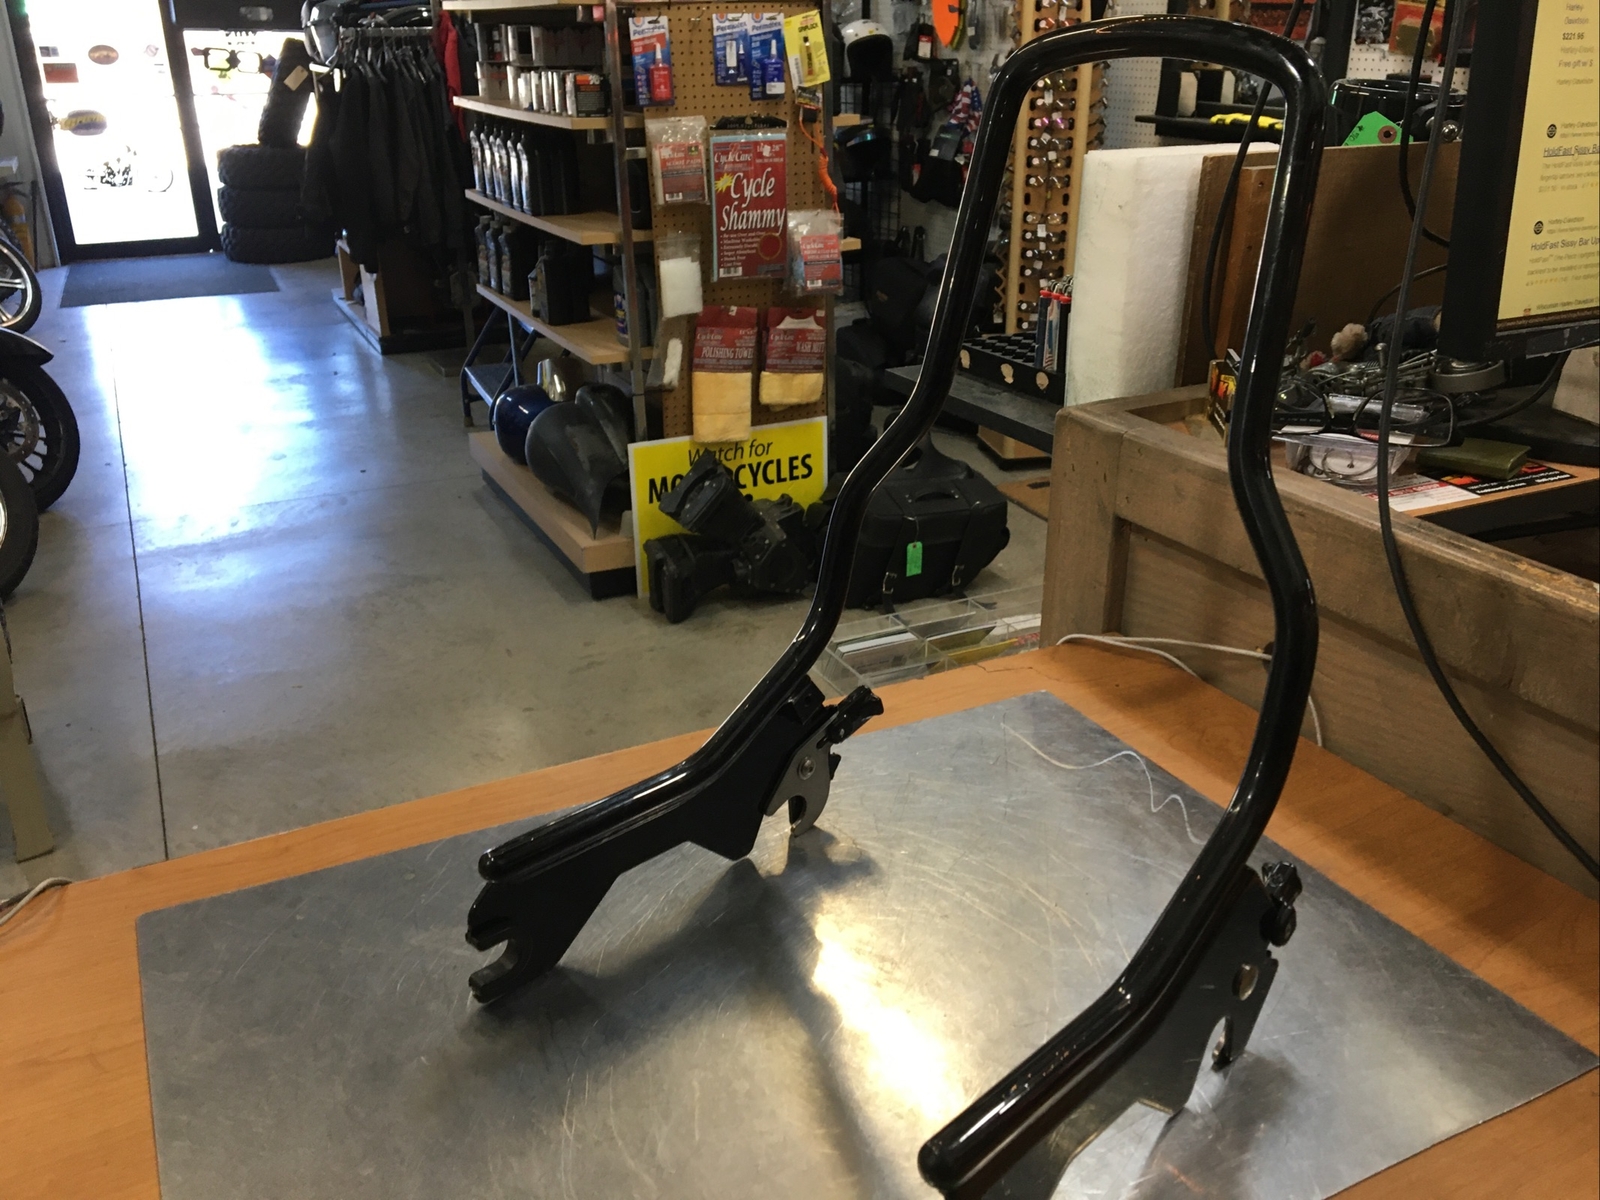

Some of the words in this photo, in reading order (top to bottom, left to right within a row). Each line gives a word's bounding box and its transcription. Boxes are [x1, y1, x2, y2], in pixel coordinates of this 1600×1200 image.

[752, 22, 781, 31] Permatex
[1543, 146, 1573, 156] HoldFast
[730, 167, 775, 208] Cycle
[720, 201, 786, 236] Shammy
[1530, 241, 1560, 251] HoldFast
[1560, 239, 1577, 248] Sissy
[1578, 237, 1589, 246] Bar
[701, 346, 734, 358] POLISHING
[796, 341, 812, 352] WASH
[749, 439, 773, 458] for
[648, 454, 813, 504] MOCYCLES
